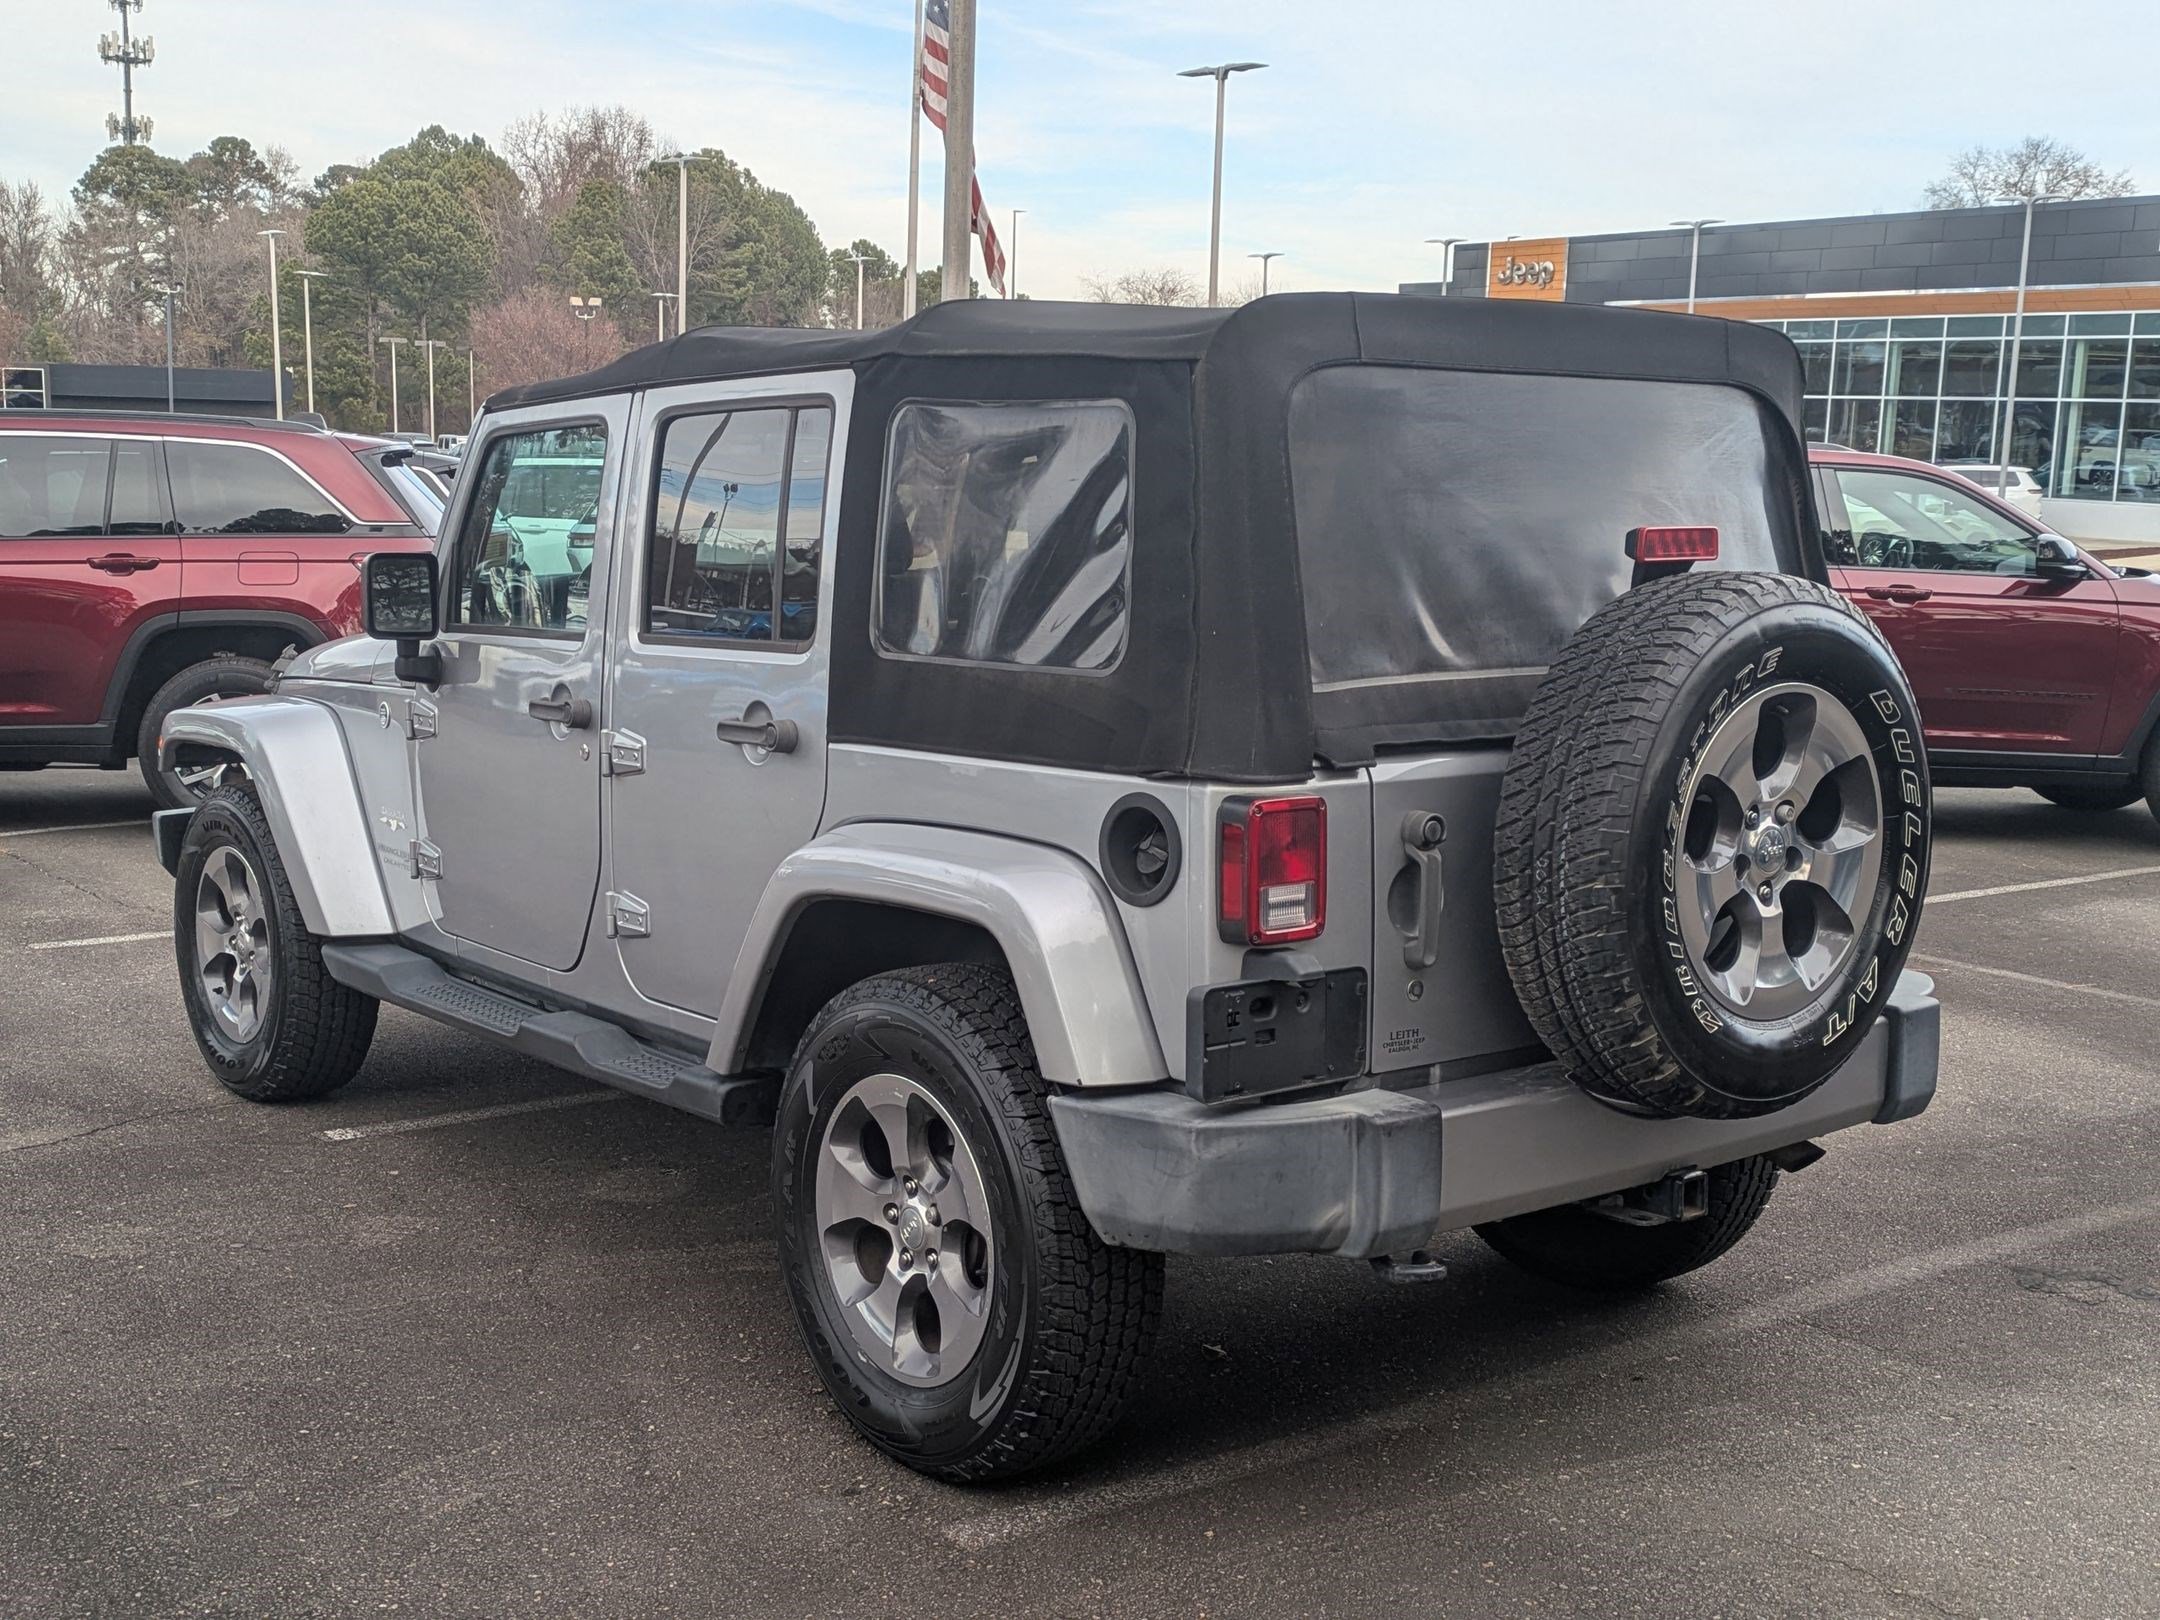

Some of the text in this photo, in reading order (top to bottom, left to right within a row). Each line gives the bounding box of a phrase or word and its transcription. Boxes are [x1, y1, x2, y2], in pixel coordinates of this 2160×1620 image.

[1498, 256, 1555, 290] Jeep
[1662, 646, 1784, 1034] BRIDGESTONE
[1869, 689, 1921, 945] DUELER
[1390, 1028, 1419, 1041] LEITH
[1823, 957, 1878, 1046] A/T
